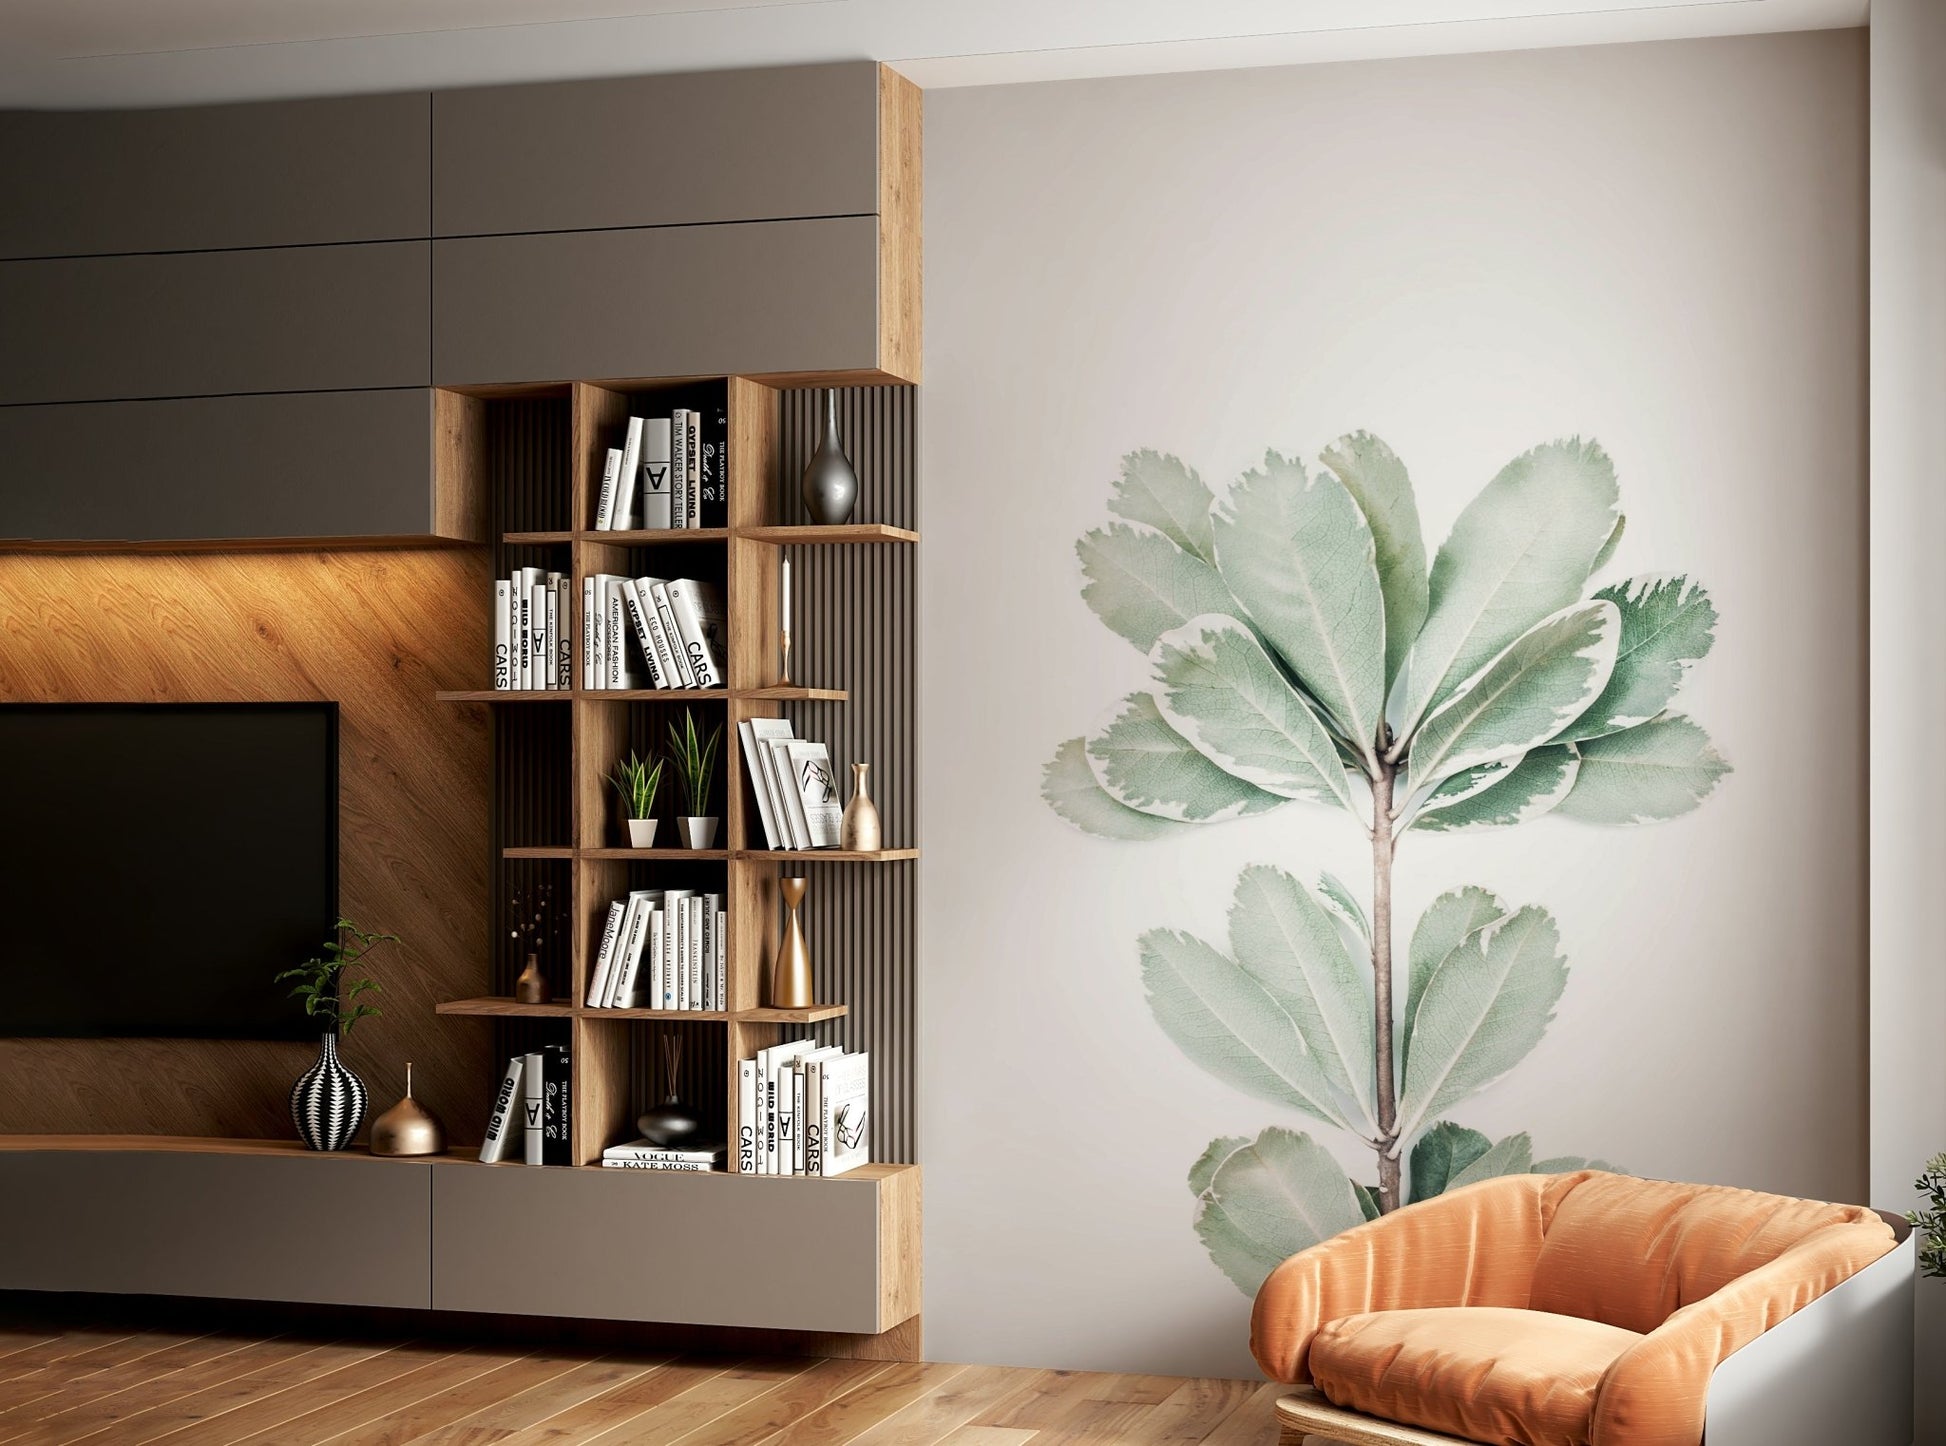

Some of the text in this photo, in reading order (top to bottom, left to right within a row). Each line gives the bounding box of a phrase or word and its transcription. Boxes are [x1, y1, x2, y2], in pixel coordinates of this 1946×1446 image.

[646, 467, 666, 490] A
[674, 422, 683, 529] TIM WALKER STORY TELLER
[688, 426, 696, 518] GYPSET LIVING
[533, 633, 544, 653] A
[628, 599, 660, 682] GYPSET LIVING
[649, 617, 670, 663] ECO HOUSES
[496, 644, 507, 688] CARS
[560, 640, 570, 686] CARS
[688, 642, 712, 685] CARS
[599, 905, 620, 959] JaneMoore
[486, 1077, 515, 1141] WILD WORLD
[524, 1103, 540, 1126] A
[780, 1117, 790, 1137] A
[624, 1161, 699, 1171] KATE MOSS
[634, 1152, 685, 1162] VOGUE
[741, 1126, 752, 1171] CARS
[808, 1124, 819, 1172] CARS
